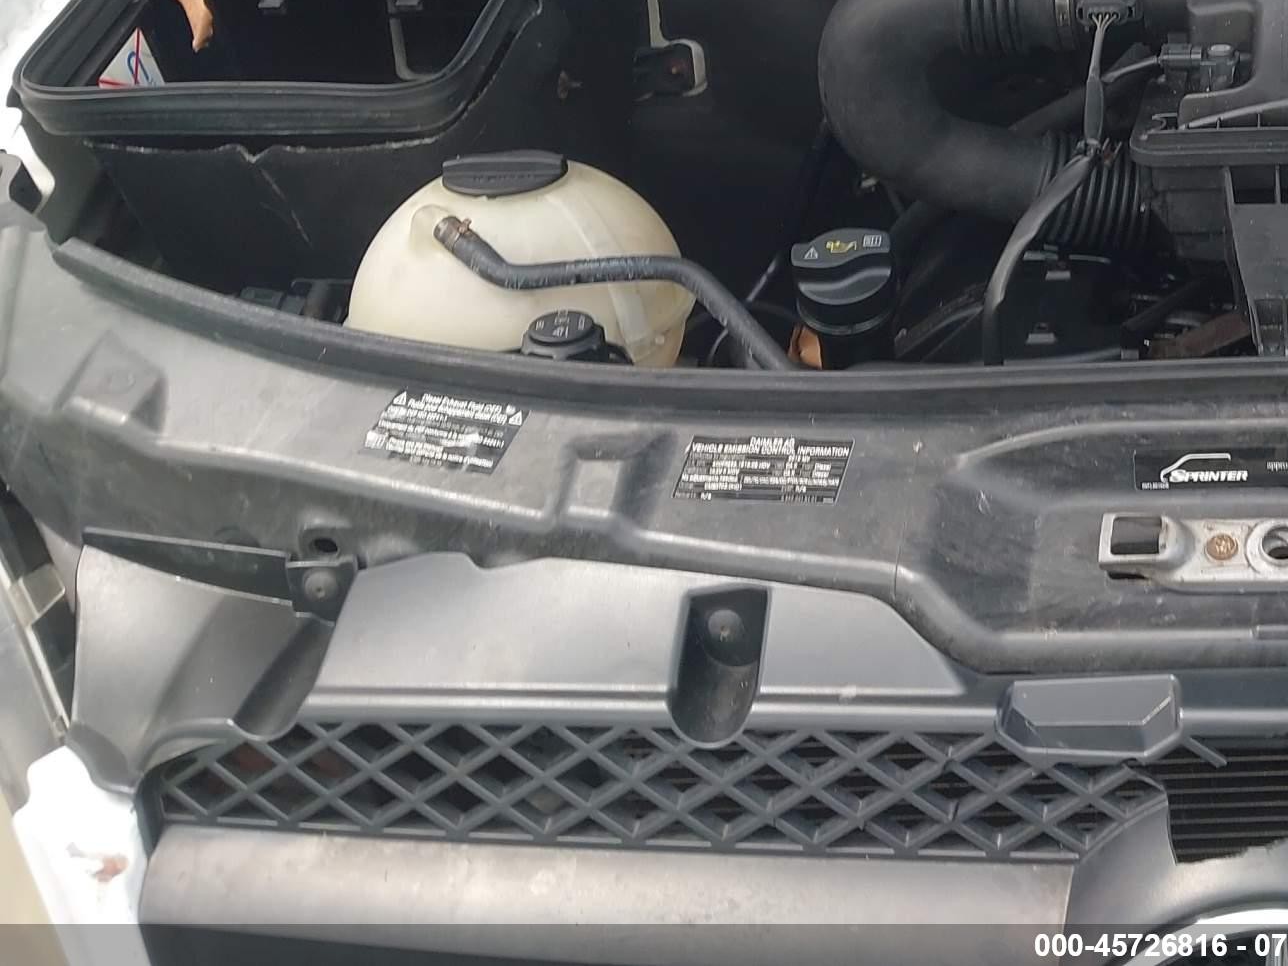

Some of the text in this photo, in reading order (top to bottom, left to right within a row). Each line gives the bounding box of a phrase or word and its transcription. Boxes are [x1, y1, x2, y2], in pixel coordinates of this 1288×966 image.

[692, 442, 723, 453] VEHICLE
[723, 443, 760, 454] EMISSION
[797, 445, 850, 457] INFORMATION
[1169, 469, 1248, 483] SPRINTER
